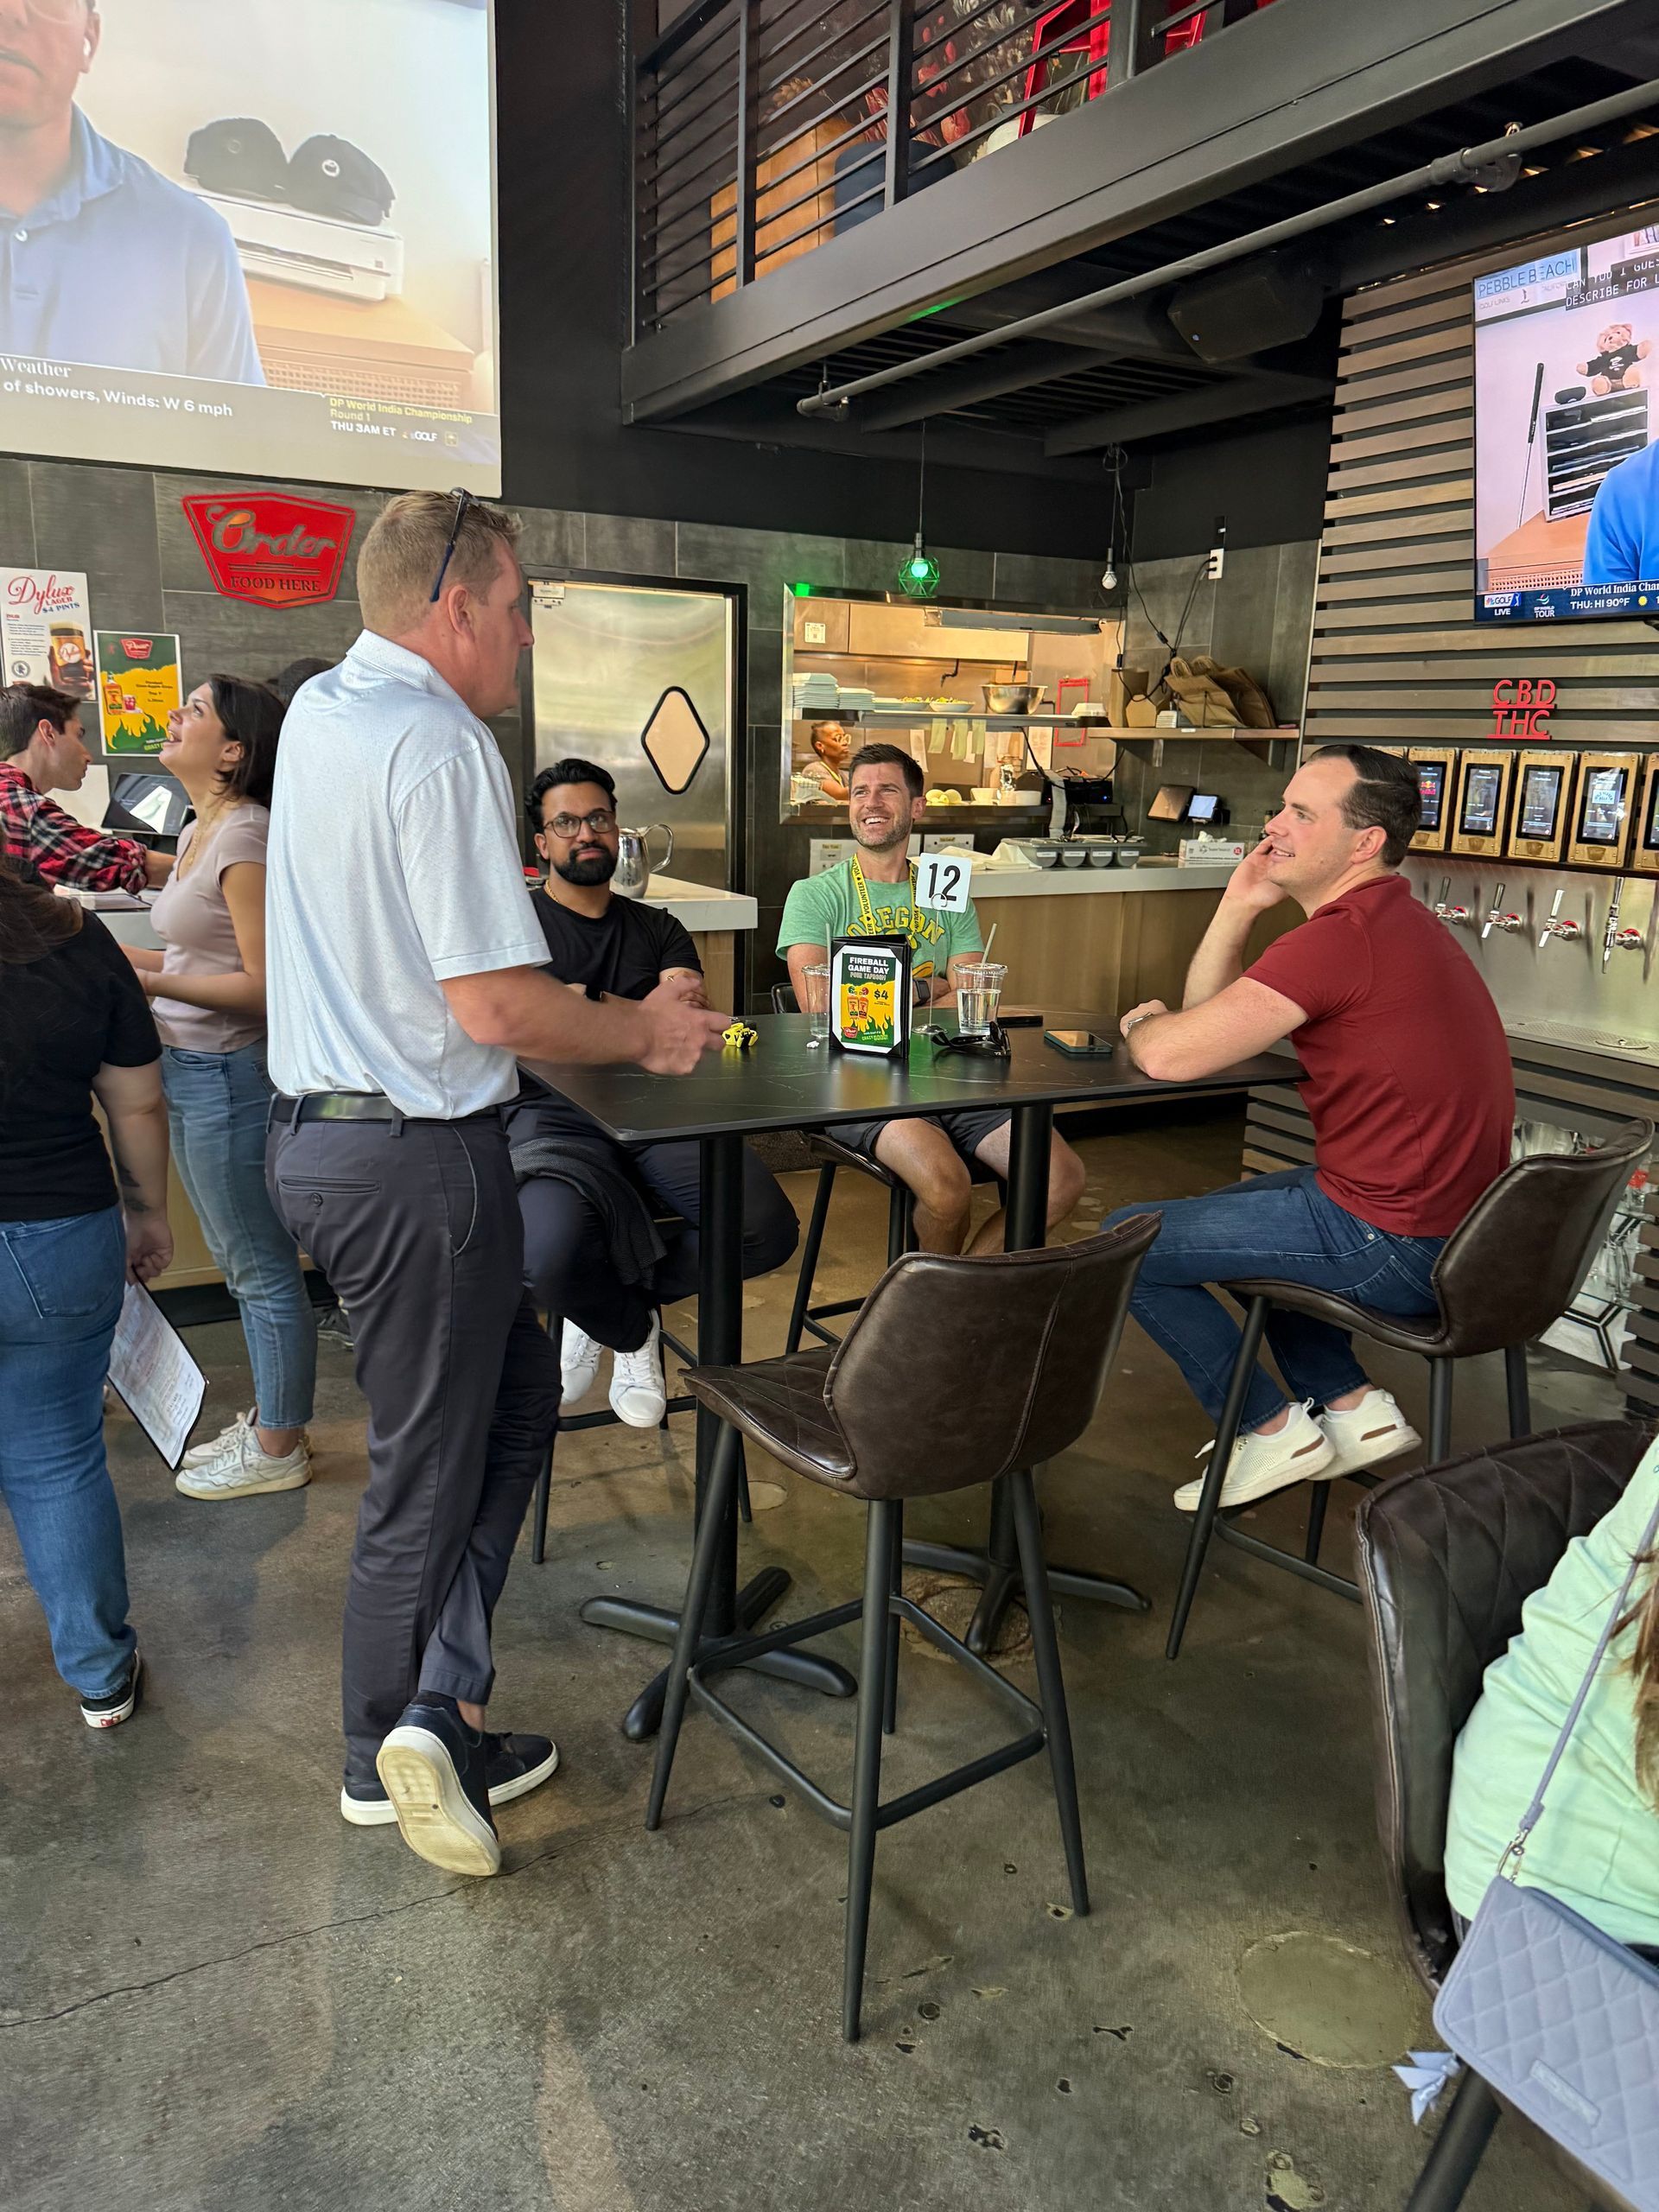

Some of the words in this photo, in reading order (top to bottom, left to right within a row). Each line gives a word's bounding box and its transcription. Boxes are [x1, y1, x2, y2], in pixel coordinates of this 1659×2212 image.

[1478, 274, 1527, 297] PEBBLE
[1566, 283, 1619, 307] DESCRIBE
[1626, 276, 1647, 293] FOR
[0, 357, 72, 378] Weather
[3, 379, 22, 392] of
[24, 381, 101, 404] showers,
[103, 389, 160, 408] Winds:
[163, 397, 181, 410] W
[183, 399, 195, 412] 6
[199, 401, 233, 417] mph
[329, 397, 345, 407] DP
[346, 399, 376, 411] World
[378, 404, 403, 415] India
[404, 407, 473, 424] Championship
[330, 410, 364, 422] Round
[331, 421, 353, 432] THU
[356, 424, 380, 435] 3AM
[383, 427, 397, 436] ET
[414, 430, 437, 442] GOLF
[206, 505, 337, 558] Order
[230, 575, 276, 589] FOOD
[279, 579, 321, 592] HERE
[1571, 588, 1582, 597] DP
[1584, 584, 1611, 595] World
[1613, 582, 1637, 593] India
[8, 574, 76, 615] Dylux
[45, 596, 73, 607] LAGER
[1495, 595, 1512, 605] GOLF
[1570, 601, 1593, 610] THU:
[1594, 599, 1605, 608] HI
[1606, 597, 1630, 607] 90°F
[56, 602, 80, 611] PINTS
[1534, 610, 1554, 619] TOUR
[1491, 679, 1556, 706] CBD
[1490, 710, 1550, 737] THC
[928, 862, 962, 902] 12
[858, 881, 869, 915] VOLUNTEER
[848, 964, 872, 973] GAME
[873, 966, 889, 975] DAY
[849, 957, 888, 967] FIREBALL
[874, 988, 889, 1001] $4
